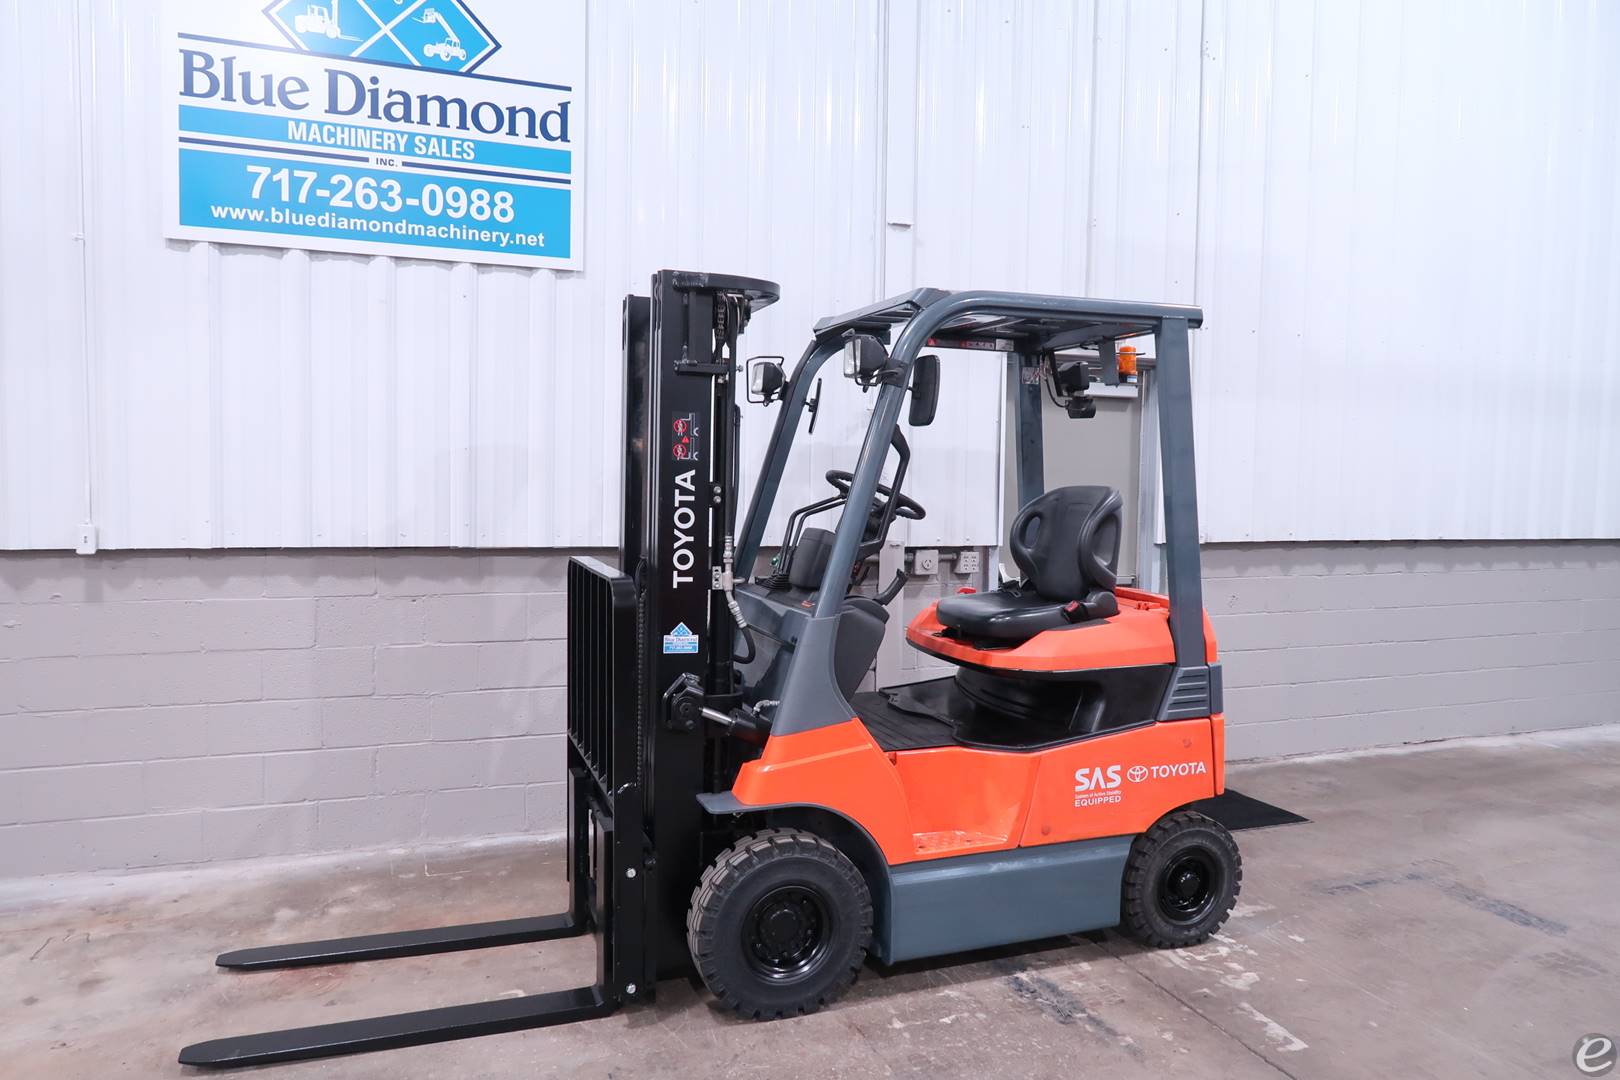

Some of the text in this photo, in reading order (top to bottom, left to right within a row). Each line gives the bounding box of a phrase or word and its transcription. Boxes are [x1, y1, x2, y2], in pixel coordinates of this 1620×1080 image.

[179, 49, 571, 143] Blue Diamond
[287, 120, 476, 161] MACHINERY SALES
[375, 157, 399, 167] INC.
[246, 165, 515, 224] 717-263-0988
[210, 205, 545, 247] www.bluediamondmachinery.net
[672, 469, 696, 589] TOYOTA
[1074, 765, 1122, 792] SAS
[1151, 761, 1207, 779] TOYOTA
[1075, 795, 1122, 807] EQUIPPED
